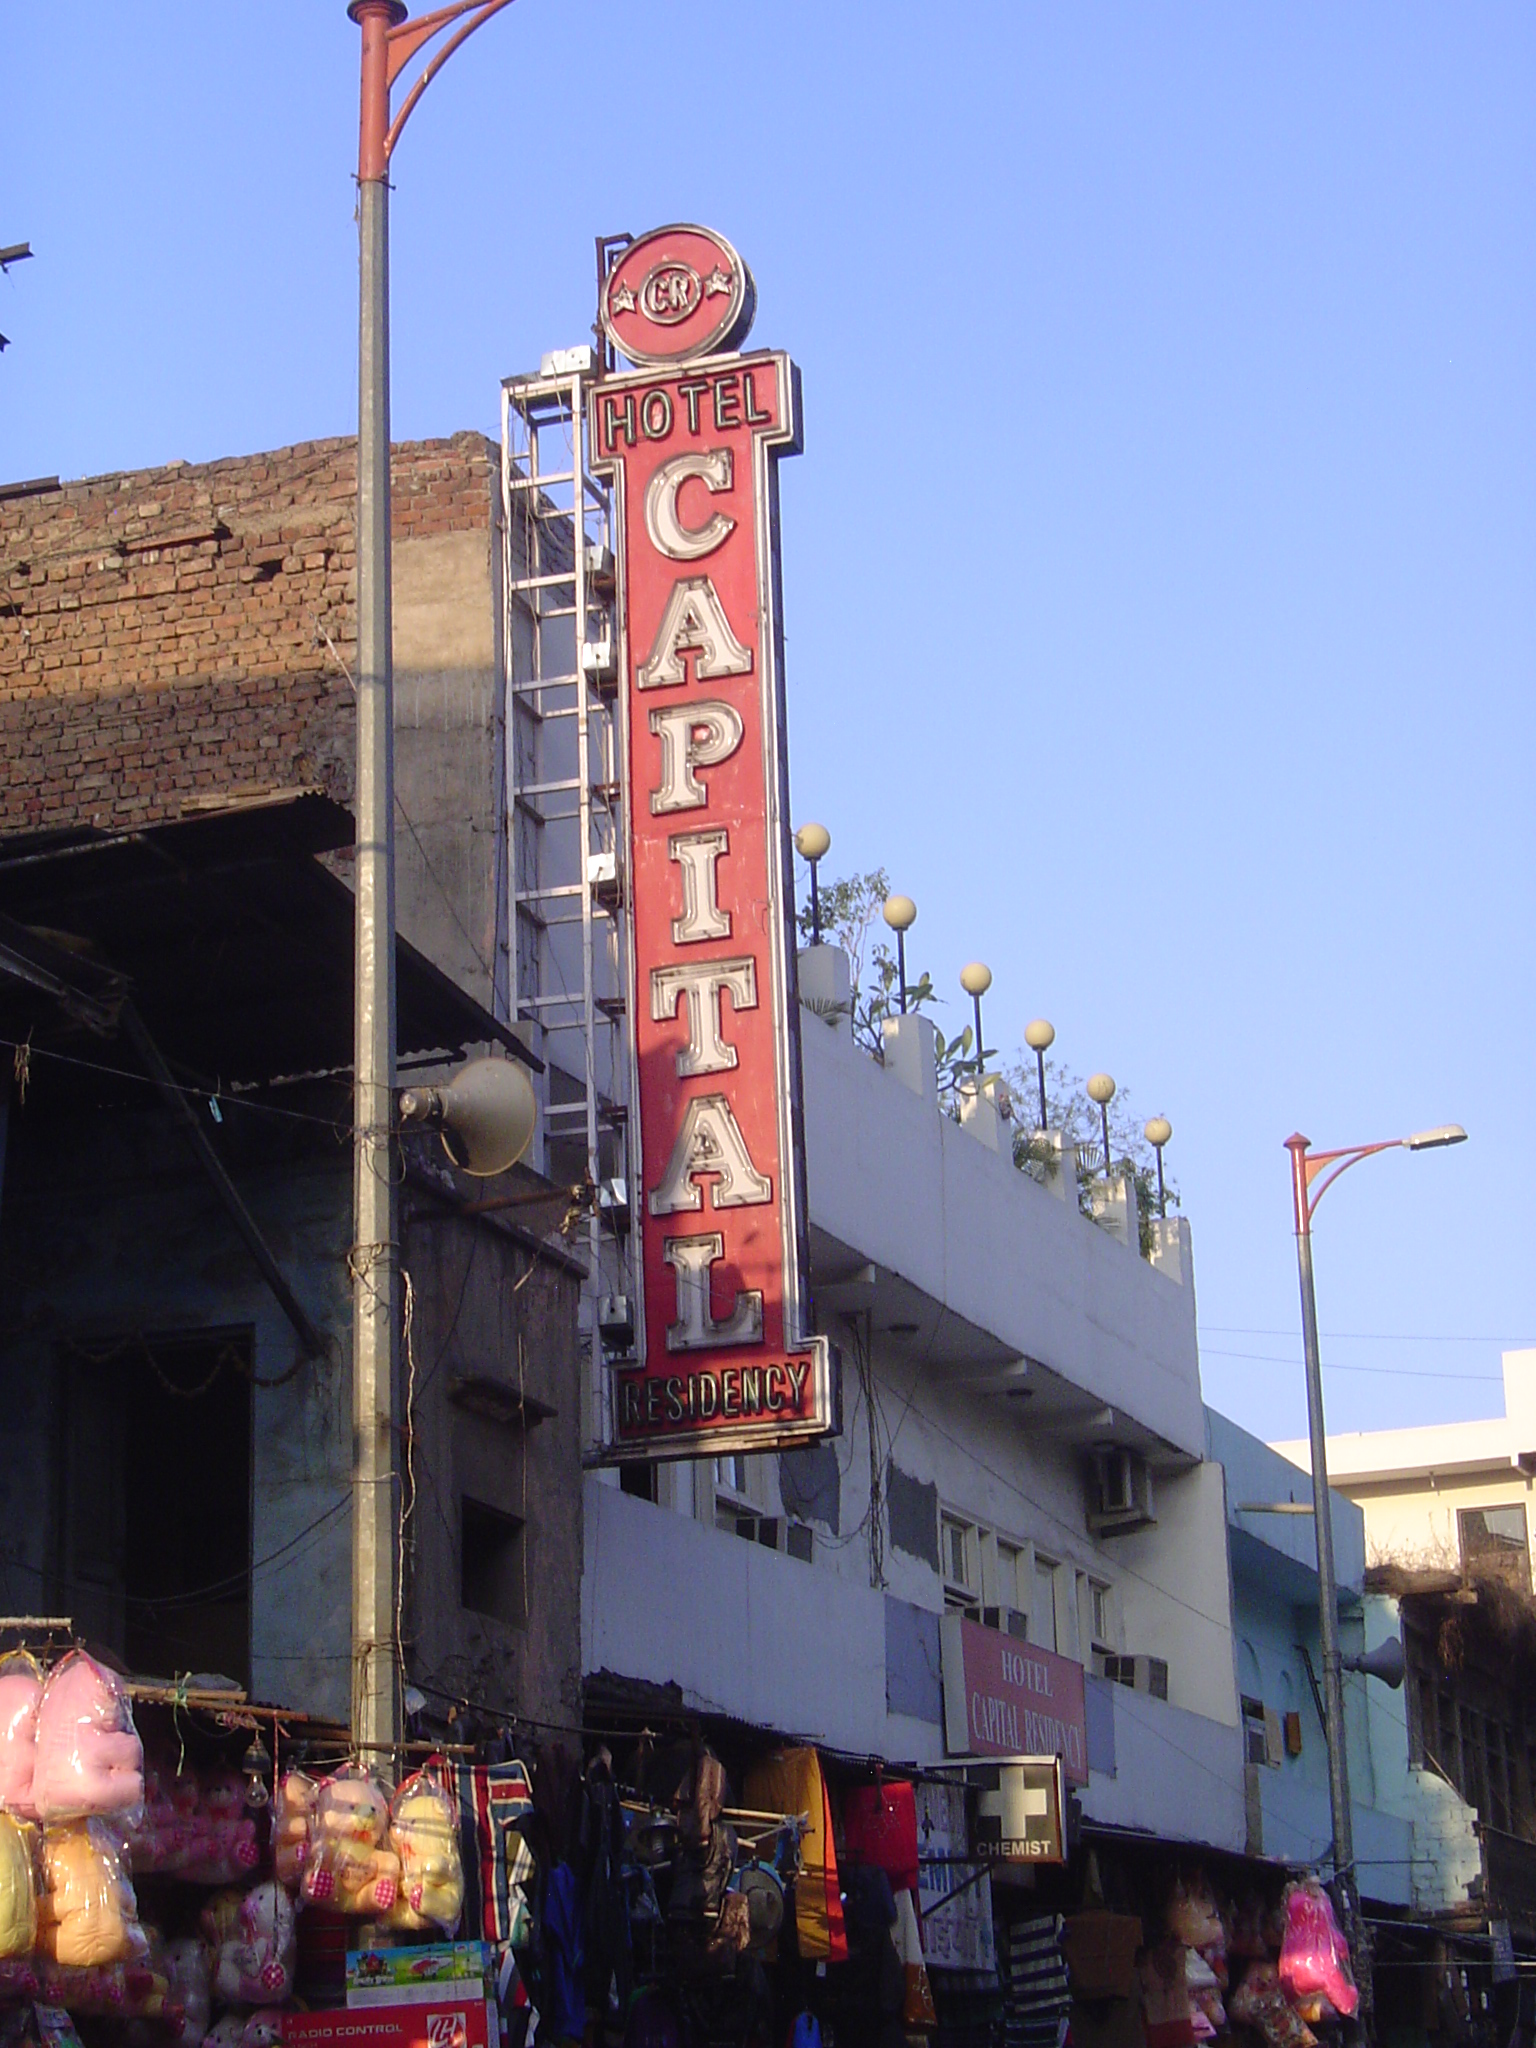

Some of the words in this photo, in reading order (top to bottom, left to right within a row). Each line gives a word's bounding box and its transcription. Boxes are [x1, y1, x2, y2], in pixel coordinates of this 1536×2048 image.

[646, 272, 688, 312] CR
[605, 373, 771, 450] HOTEL
[636, 447, 772, 1352] CAPITAL
[622, 1361, 810, 1426] RESIDENCY
[1001, 1649, 1054, 1698] HOTEL
[972, 1690, 1022, 1750] CAPITAL
[1024, 1708, 1083, 1769] RESIDENCY
[977, 1840, 1052, 1858] CHEMIST
[287, 2026, 333, 2040] RADIO
[336, 2022, 403, 2037] CONTROL
